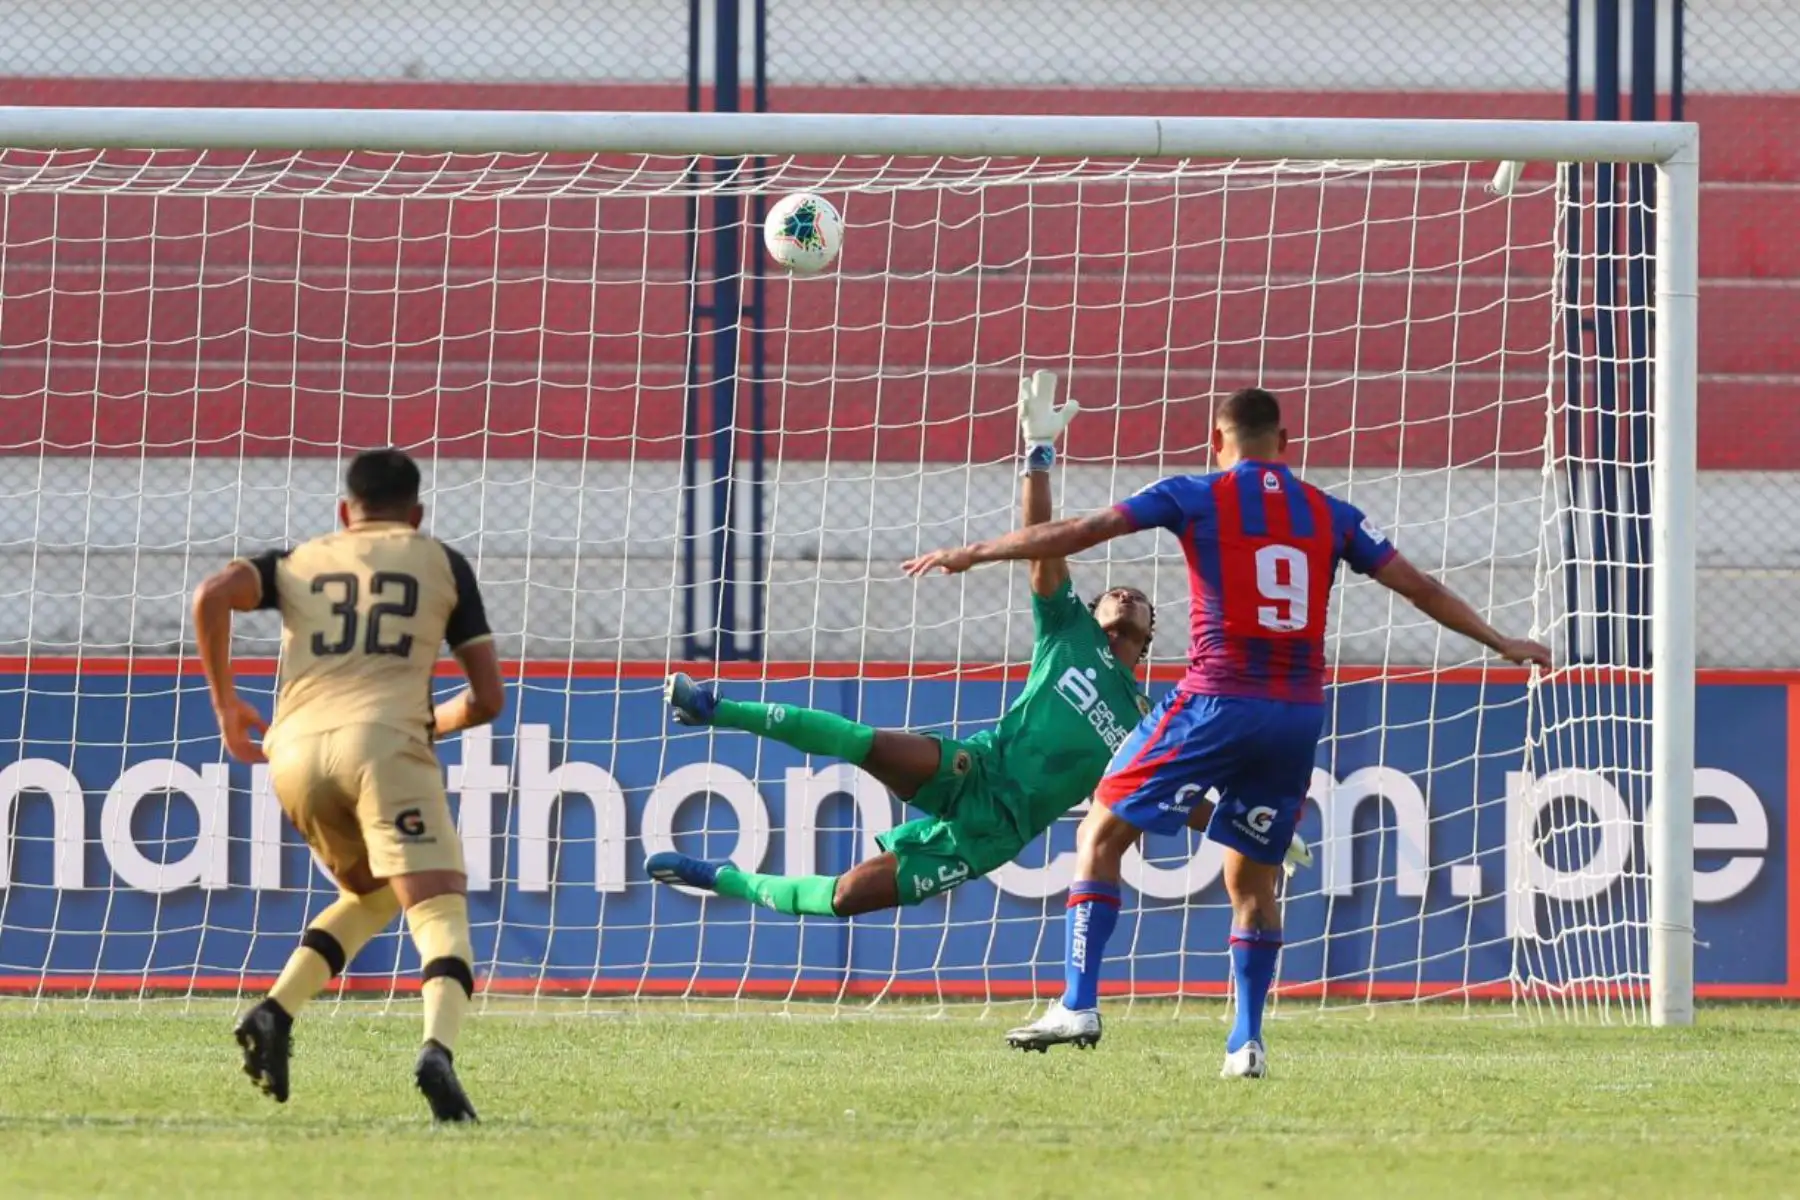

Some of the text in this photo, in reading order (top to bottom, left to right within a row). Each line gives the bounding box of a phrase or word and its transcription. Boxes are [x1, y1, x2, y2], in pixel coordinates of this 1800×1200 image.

[310, 572, 419, 657] 32
[1255, 544, 1309, 632] 9
[1247, 805, 1278, 833] G
